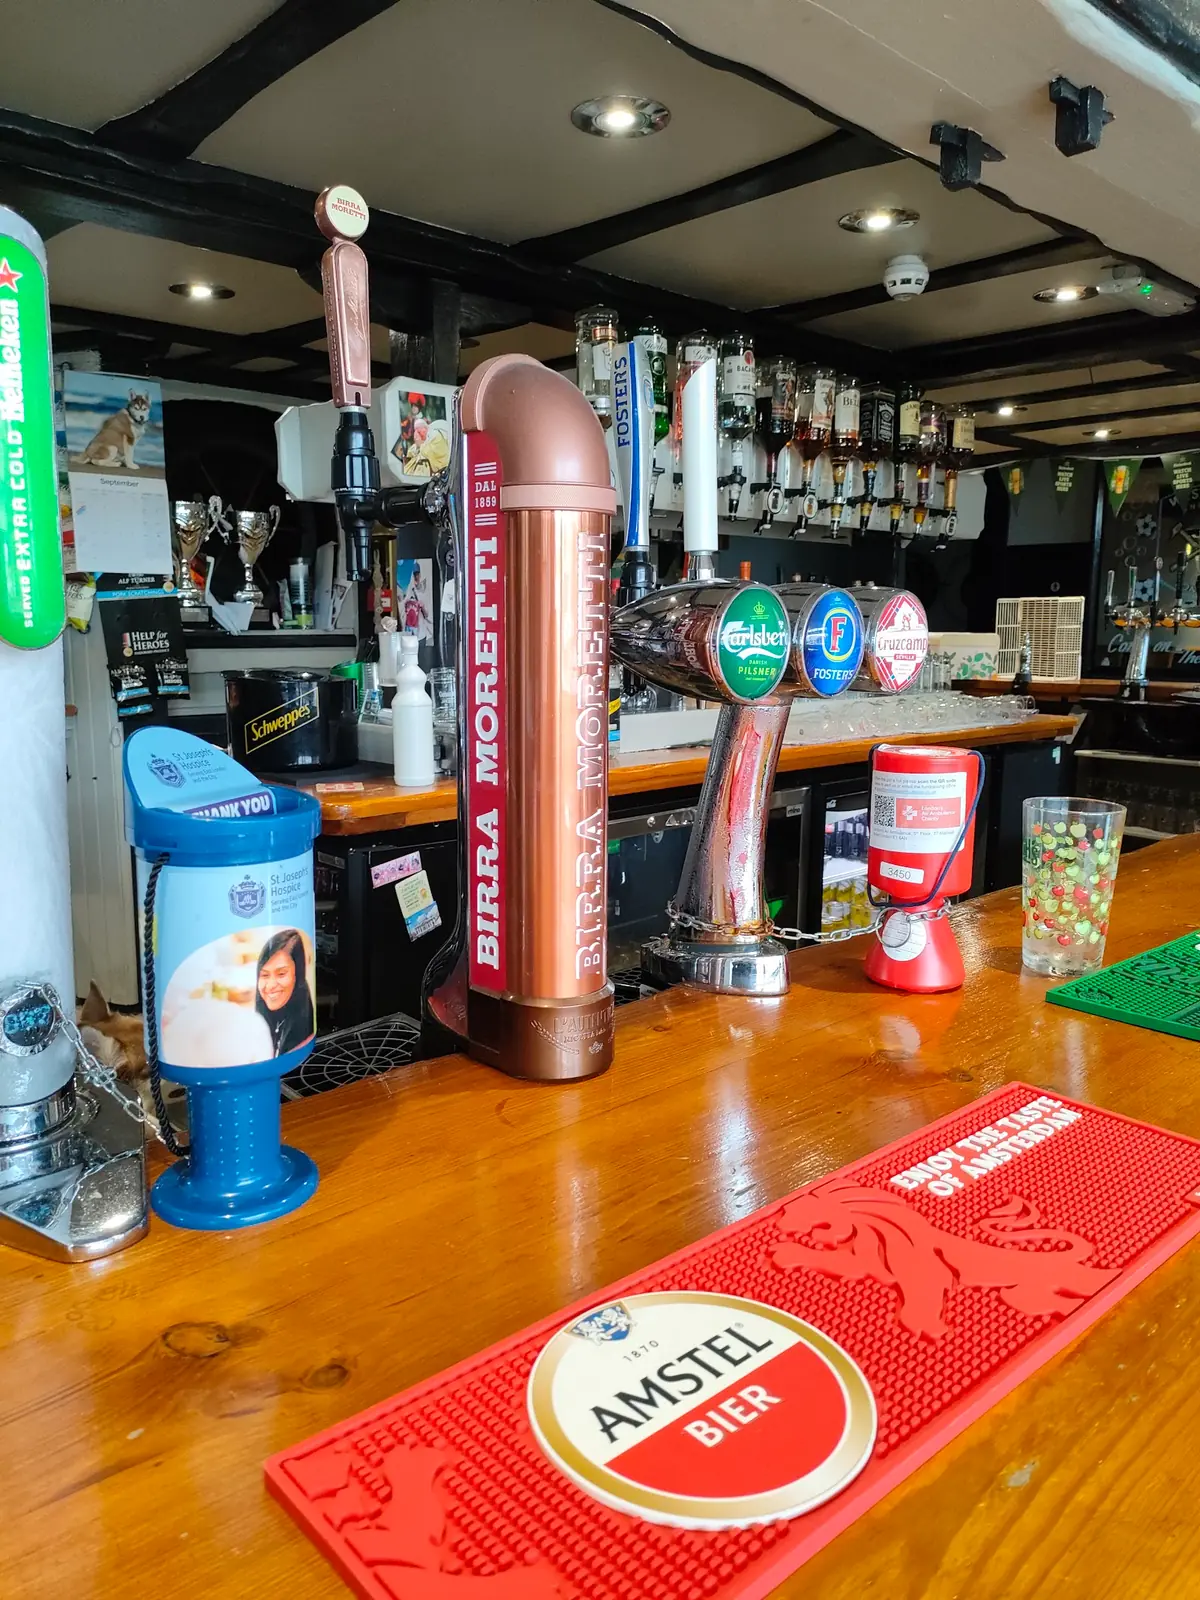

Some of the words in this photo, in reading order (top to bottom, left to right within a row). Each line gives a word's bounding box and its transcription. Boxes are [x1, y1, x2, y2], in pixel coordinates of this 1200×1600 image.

[331, 203, 367, 221] MORETTI
[337, 197, 361, 211] BIRRA
[7, 429, 26, 491] COLD
[100, 478, 140, 487] September
[475, 481, 497, 492] DAL
[12, 497, 33, 571] EXTRA
[19, 575, 34, 628] SERVED
[131, 631, 155, 642] HELP
[155, 630, 168, 641] for
[133, 639, 170, 651] HEROES
[829, 616, 846, 652] F
[475, 536, 498, 786] MORETTI
[575, 530, 606, 790] MORETTI
[738, 666, 776, 676] PILSNER
[251, 703, 311, 742] Schweppes
[179, 760, 211, 770] Hospice
[240, 794, 271, 815] YOU
[270, 874, 280, 886] St
[887, 867, 912, 880] 3450
[271, 882, 301, 897] Hospice
[476, 807, 500, 970] BIRRA
[575, 808, 604, 980] BIRRA
[890, 1147, 965, 1190] ENJOY
[957, 1126, 1009, 1152] THE
[996, 1095, 1063, 1130] TASTE
[927, 1172, 965, 1197] OF
[960, 1107, 1082, 1179] AMSTERDAM
[622, 1340, 660, 1362] 1870
[589, 1327, 775, 1444] AMSTEL
[683, 1384, 783, 1448] BIER
